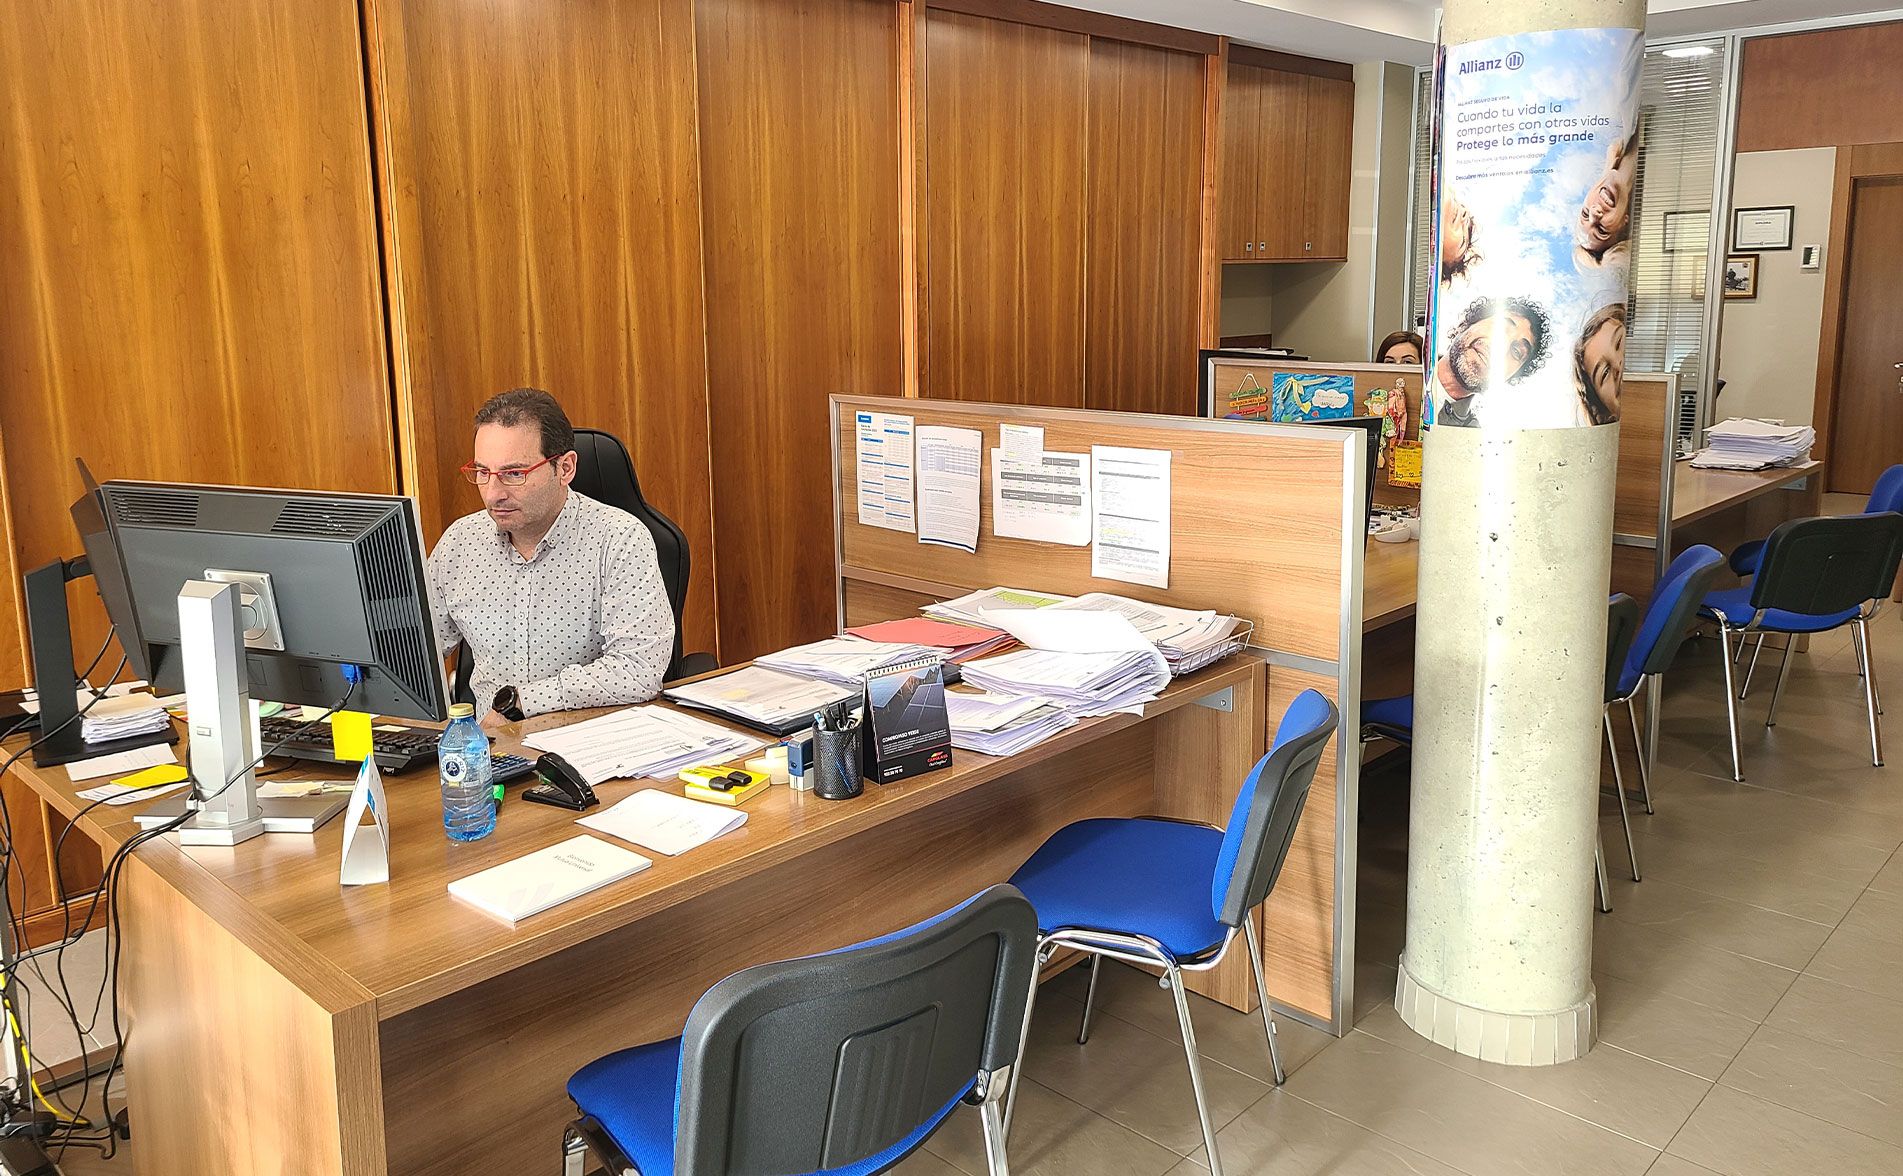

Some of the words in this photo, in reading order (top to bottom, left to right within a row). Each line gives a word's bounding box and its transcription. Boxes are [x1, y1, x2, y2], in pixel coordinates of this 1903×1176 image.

[1458, 58, 1502, 76] Allianz
[1457, 108, 1499, 123] Cuando
[1502, 107, 1514, 117] tu
[1518, 103, 1546, 116] vida
[1549, 102, 1562, 114] la
[1456, 123, 1515, 137] compartes
[1518, 121, 1542, 131] con
[1545, 118, 1578, 129] otras
[1580, 114, 1610, 126] vidas
[1456, 140, 1499, 152] Protege
[1502, 135, 1514, 146] lo
[1517, 132, 1545, 145] más
[1548, 129, 1594, 145] grande
[1456, 173, 1476, 181] Descubre
